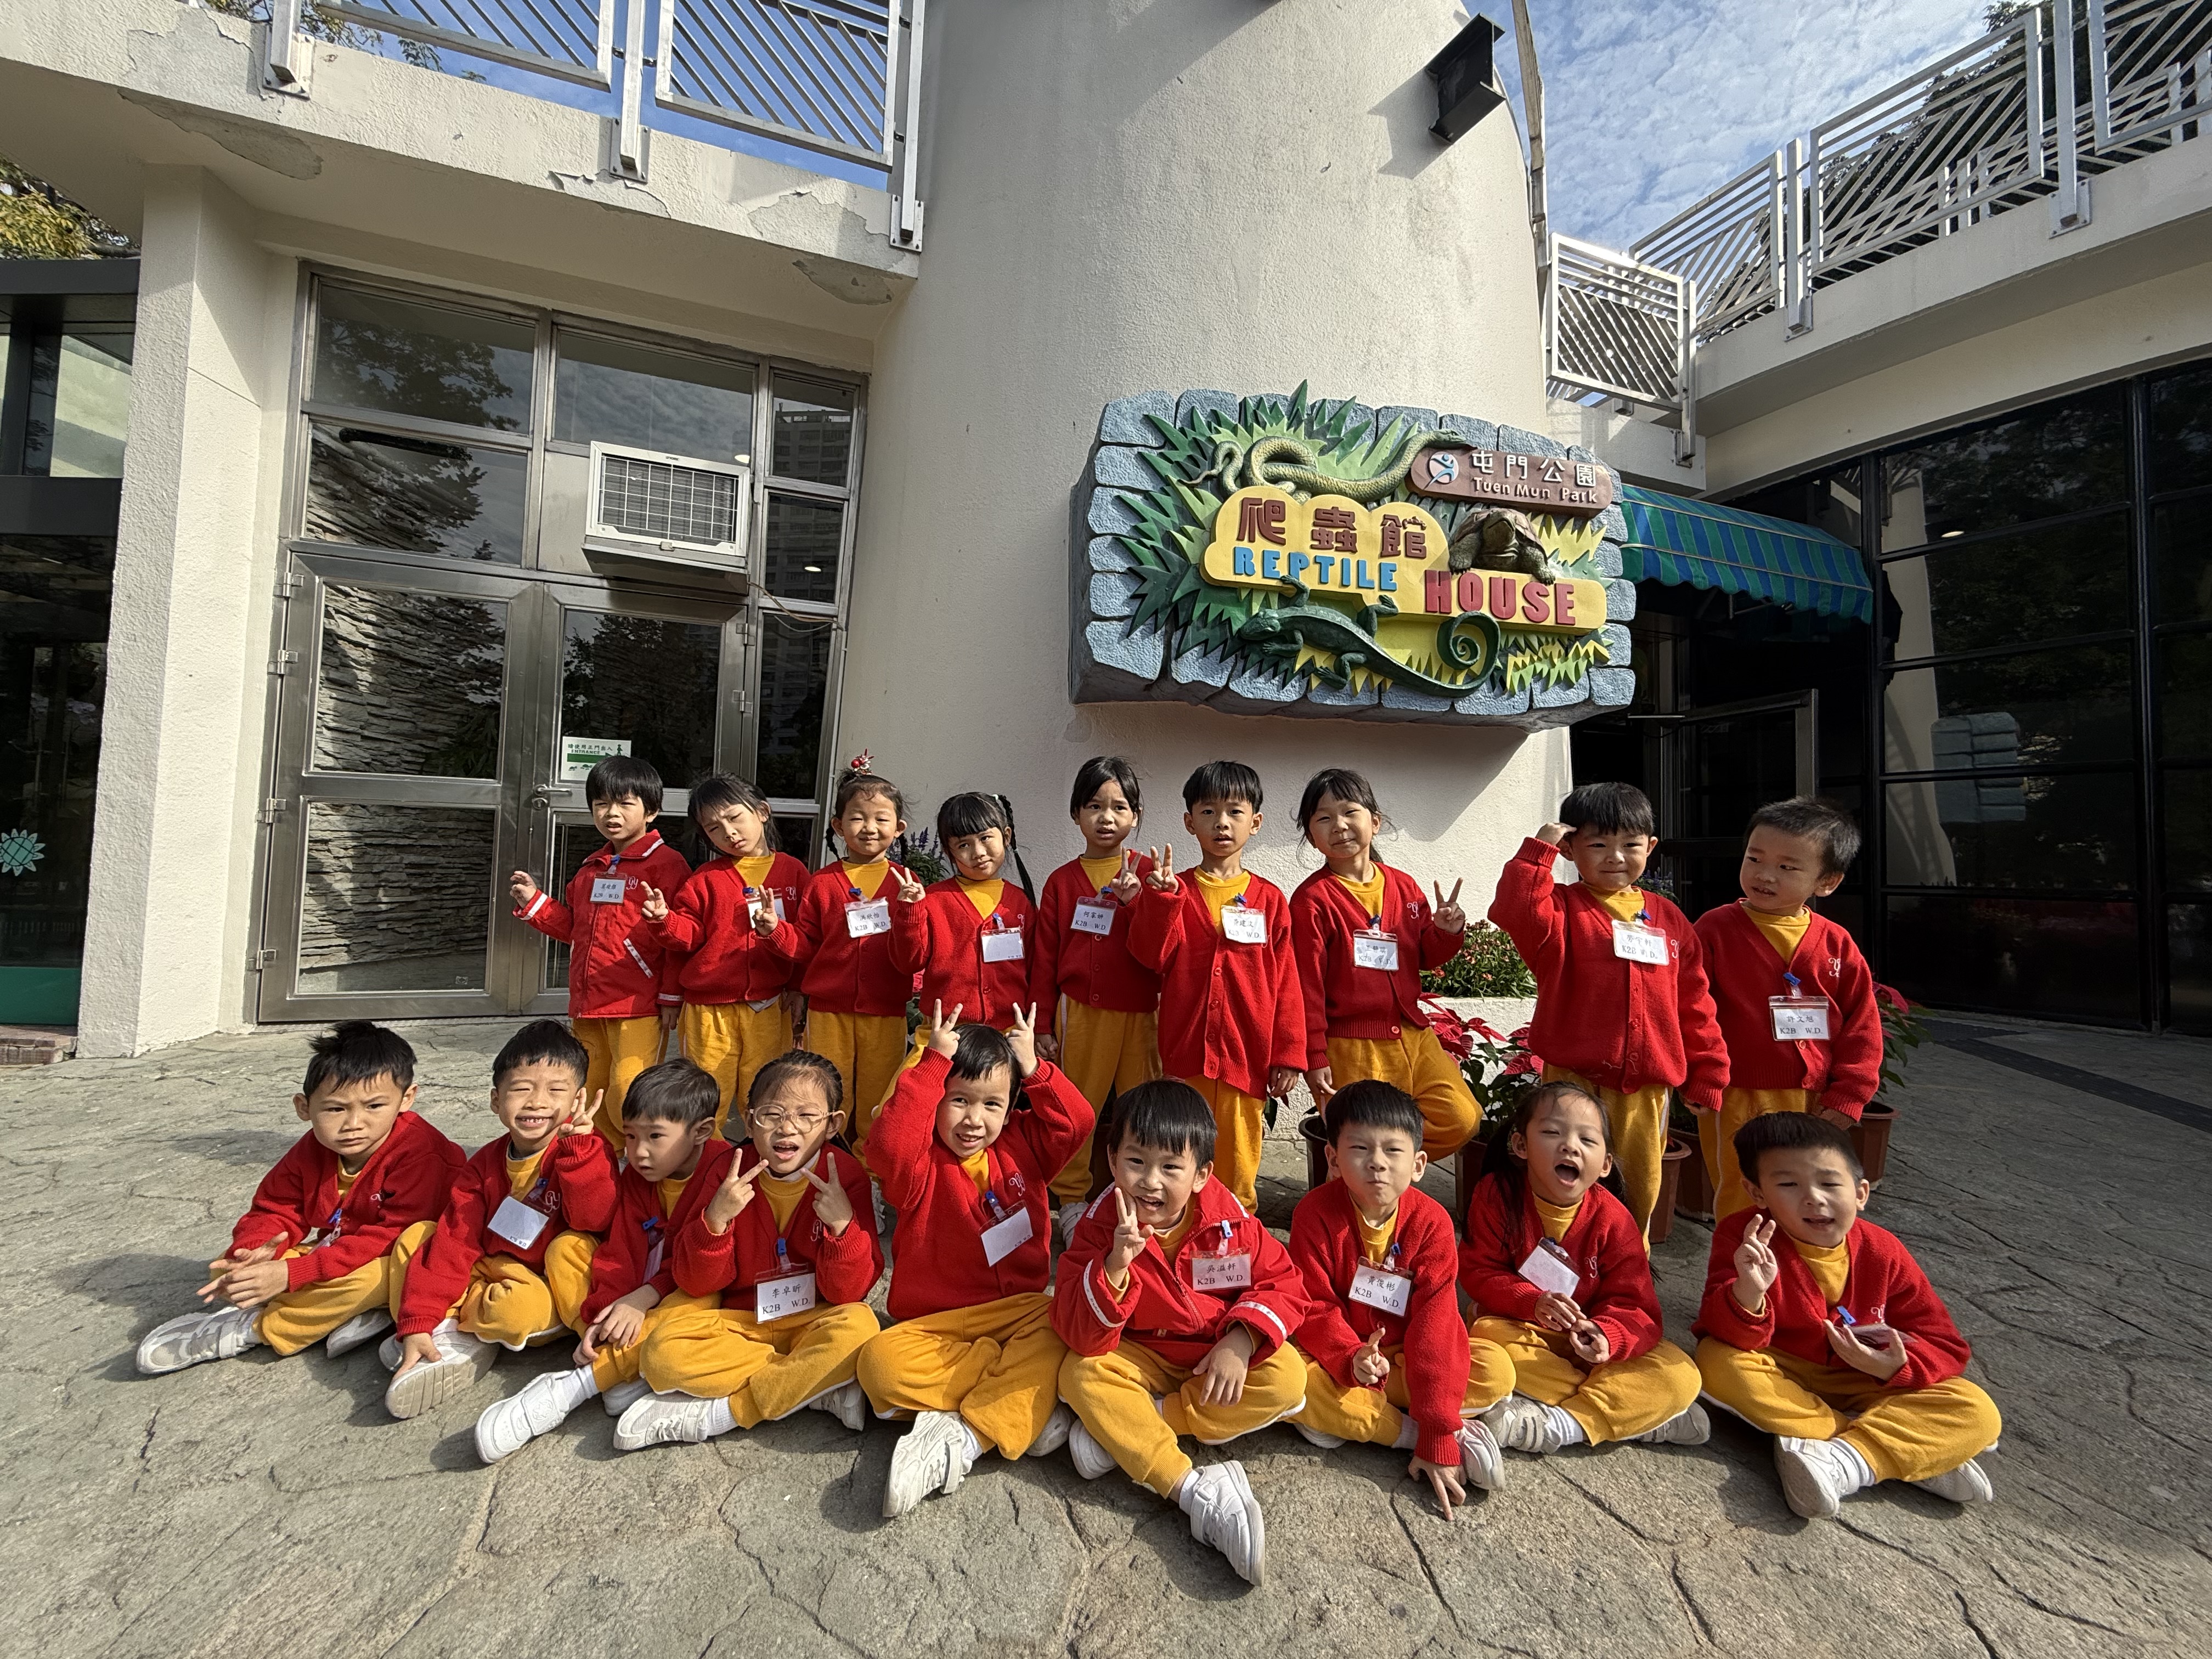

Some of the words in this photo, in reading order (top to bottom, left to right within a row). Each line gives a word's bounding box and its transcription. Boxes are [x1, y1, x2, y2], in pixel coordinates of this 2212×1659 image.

[1472, 450, 1596, 487] 屯門公園
[1473, 477, 1511, 495] Tuen
[1516, 483, 1551, 499] Mun
[1561, 487, 1598, 503] Park
[1236, 496, 1427, 559] 爬蟲館
[1233, 546, 1398, 592] REPTILE
[1425, 569, 1576, 626] HOUSE
[1622, 945, 1637, 955] K2B
[772, 1284, 802, 1299] 李卓昕
[1355, 1286, 1372, 1298] K2B
[1383, 1295, 1401, 1309] W.D.
[763, 1304, 781, 1314] K2B
[791, 1297, 811, 1308] W.D.
